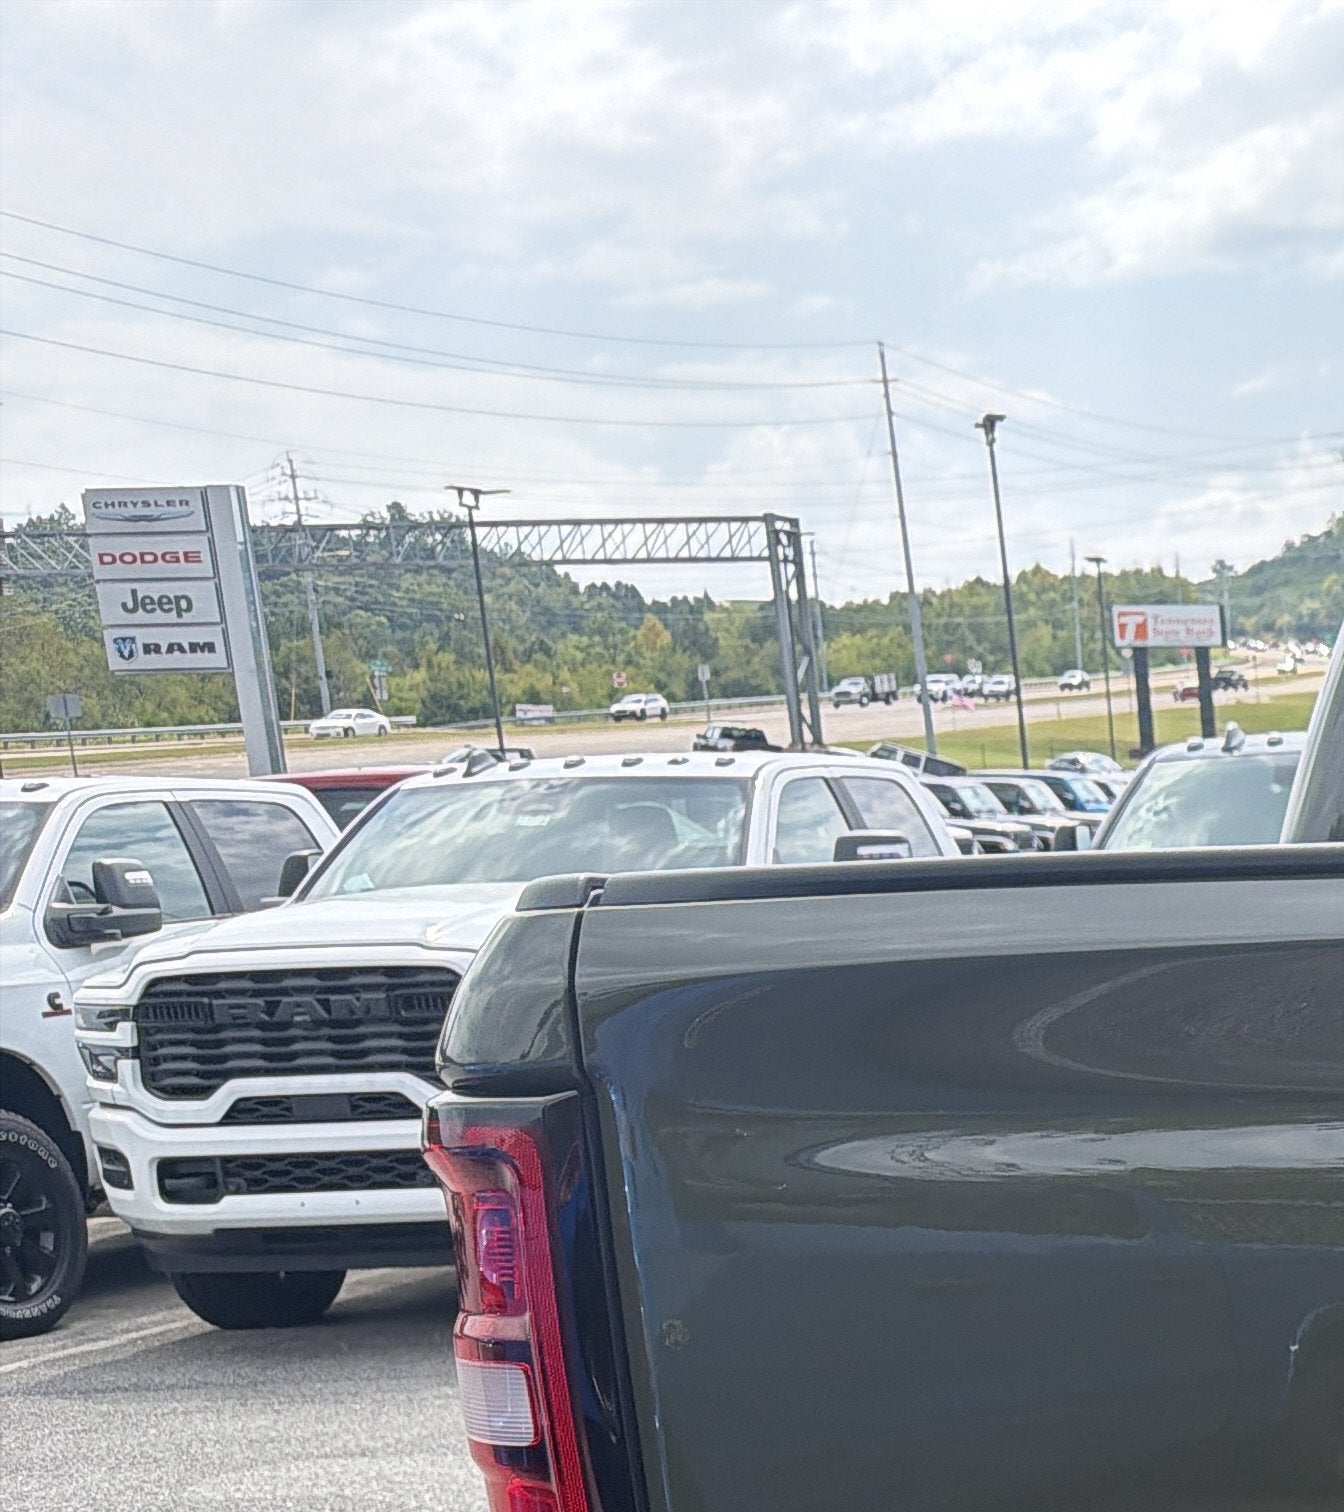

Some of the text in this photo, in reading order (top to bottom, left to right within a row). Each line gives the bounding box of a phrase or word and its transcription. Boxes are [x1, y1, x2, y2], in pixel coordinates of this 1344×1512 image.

[92, 499, 191, 509] CHRYSLER
[97, 551, 203, 566] DODGE
[121, 589, 194, 619] Jeep
[142, 641, 217, 655] RAM
[212, 994, 387, 1023] RAM
